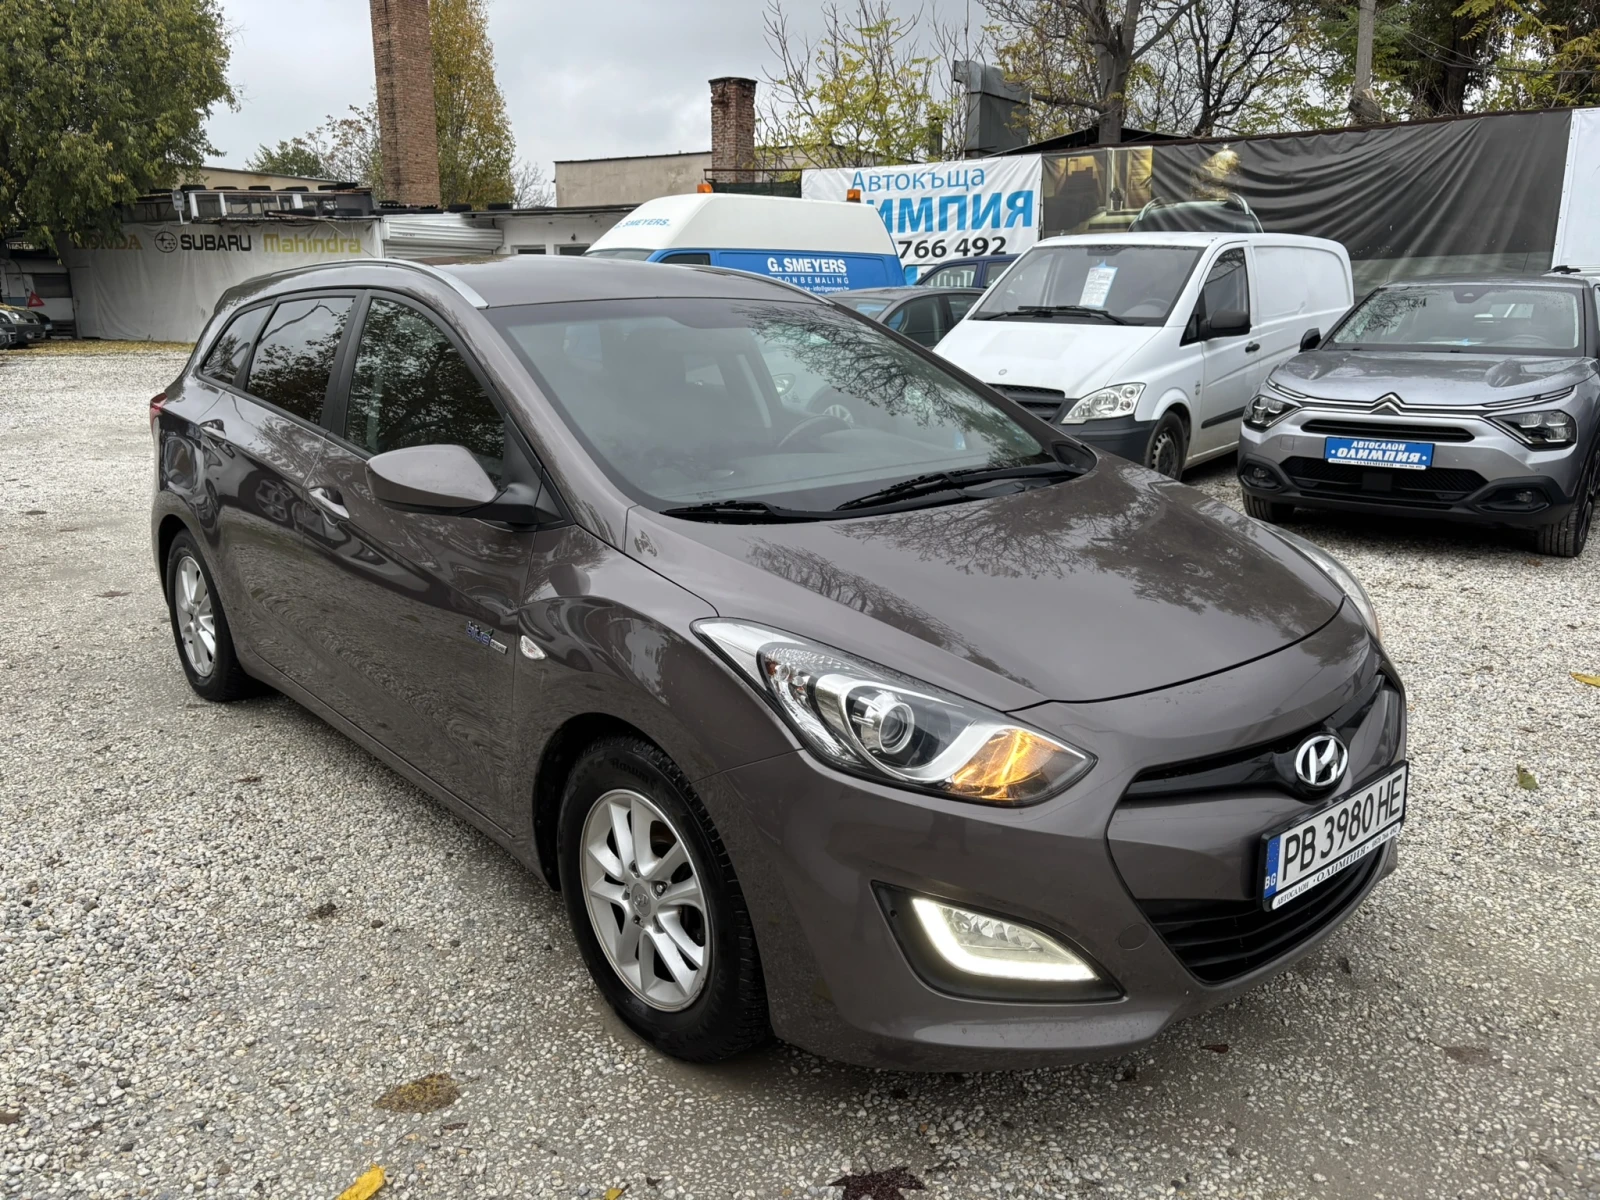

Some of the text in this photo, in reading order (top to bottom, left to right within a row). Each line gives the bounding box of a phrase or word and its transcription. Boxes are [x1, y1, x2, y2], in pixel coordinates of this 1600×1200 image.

[851, 168, 985, 193] Автокъща
[866, 190, 1034, 233] ИМПИЯ
[180, 234, 252, 252] SUBARU
[263, 233, 362, 253] Mahindra
[898, 236, 1007, 258] 766 492
[767, 257, 847, 273] G. SMEYERS
[1337, 448, 1421, 463] ОЛИМПИЯ
[1352, 441, 1406, 451] АВТОСАЛОН
[1282, 773, 1403, 882] PB 3980 HE
[1264, 872, 1277, 890] BG
